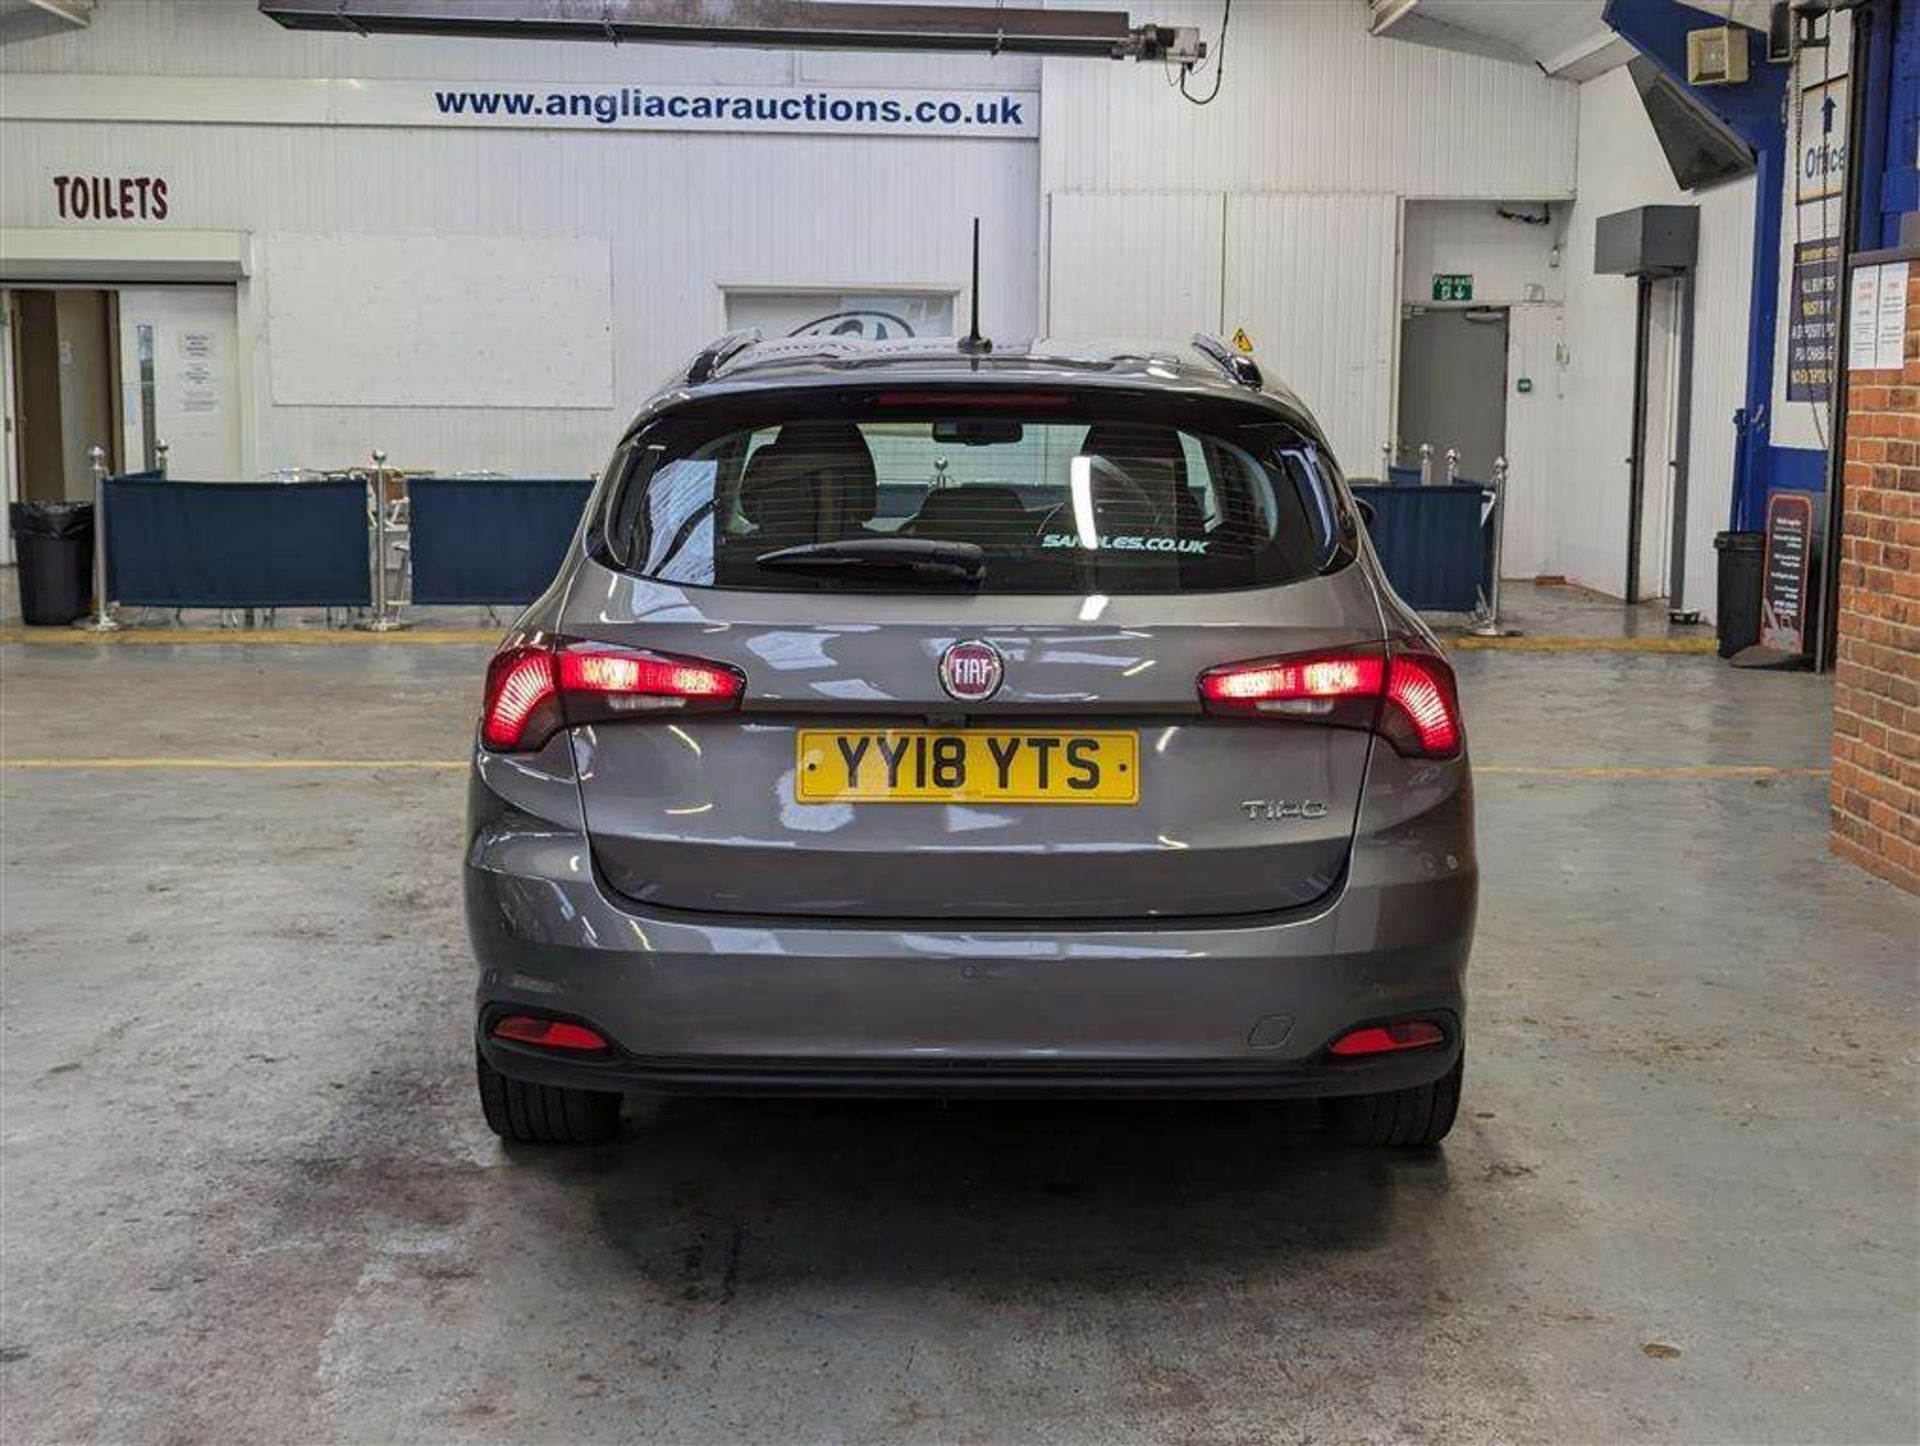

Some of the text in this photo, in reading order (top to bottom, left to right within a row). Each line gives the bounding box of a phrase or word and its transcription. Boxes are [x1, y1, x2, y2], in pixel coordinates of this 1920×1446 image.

[436, 90, 1022, 125] www.angliacarauctions.co.uk
[53, 176, 168, 219] TOILETS
[955, 659, 992, 684] FIAT
[837, 737, 1100, 790] YY18 YTS
